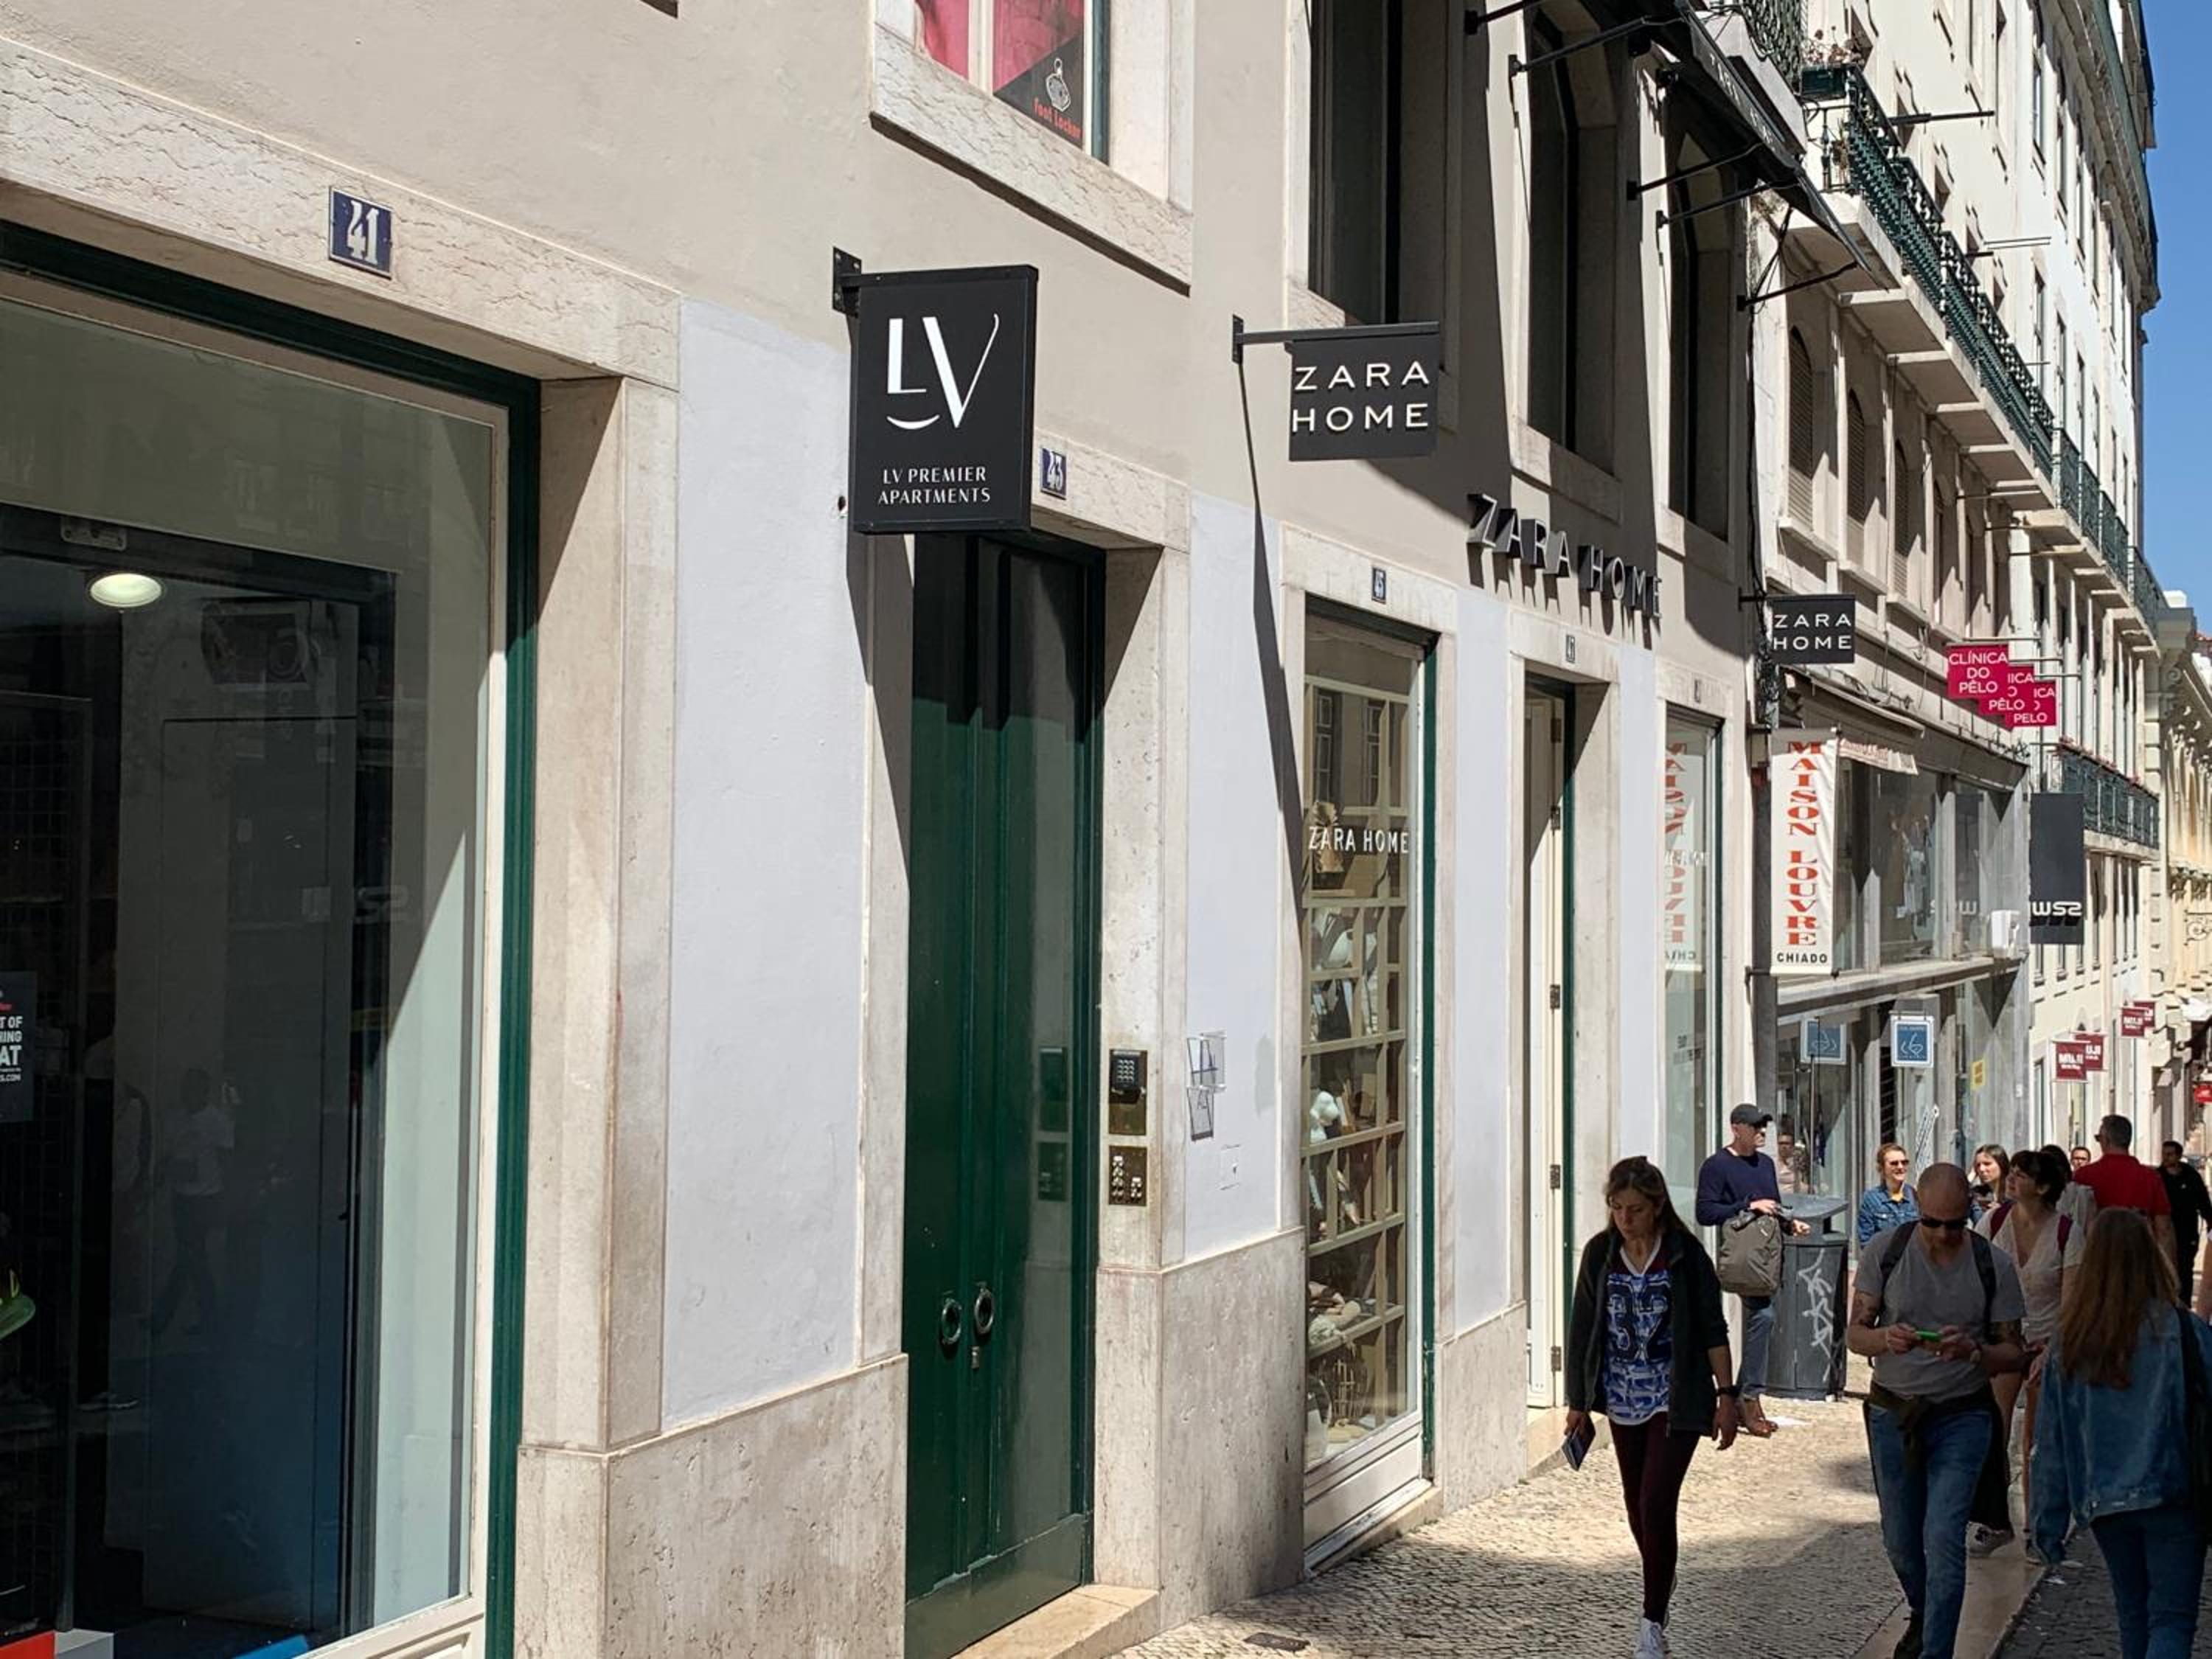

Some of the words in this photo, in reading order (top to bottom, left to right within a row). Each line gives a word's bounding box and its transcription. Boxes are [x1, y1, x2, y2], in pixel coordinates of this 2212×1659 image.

[347, 200, 380, 265] 41
[887, 313, 999, 428] LV
[1295, 361, 1430, 390] ZARA
[1292, 403, 1428, 432] HOME
[883, 469, 902, 484] LV
[908, 466, 986, 483] PREMIER
[878, 487, 990, 505] APARTMENTS
[1467, 493, 1571, 578] ZARA
[1577, 544, 1662, 619] HOME
[1774, 613, 1851, 628] ZARA
[1773, 636, 1851, 650] HOME
[1949, 650, 2008, 664] CLÍNICA
[1966, 667, 1990, 679] DO
[1959, 680, 1998, 693] PÊLO
[1787, 741, 1822, 836] MAISON
[1308, 826, 1357, 852] ZARA
[1363, 830, 1409, 853] HOME
[1786, 850, 1818, 945] LOUVRE
[1776, 952, 1828, 964] CHIADO
[7, 1016, 23, 1029] OF
